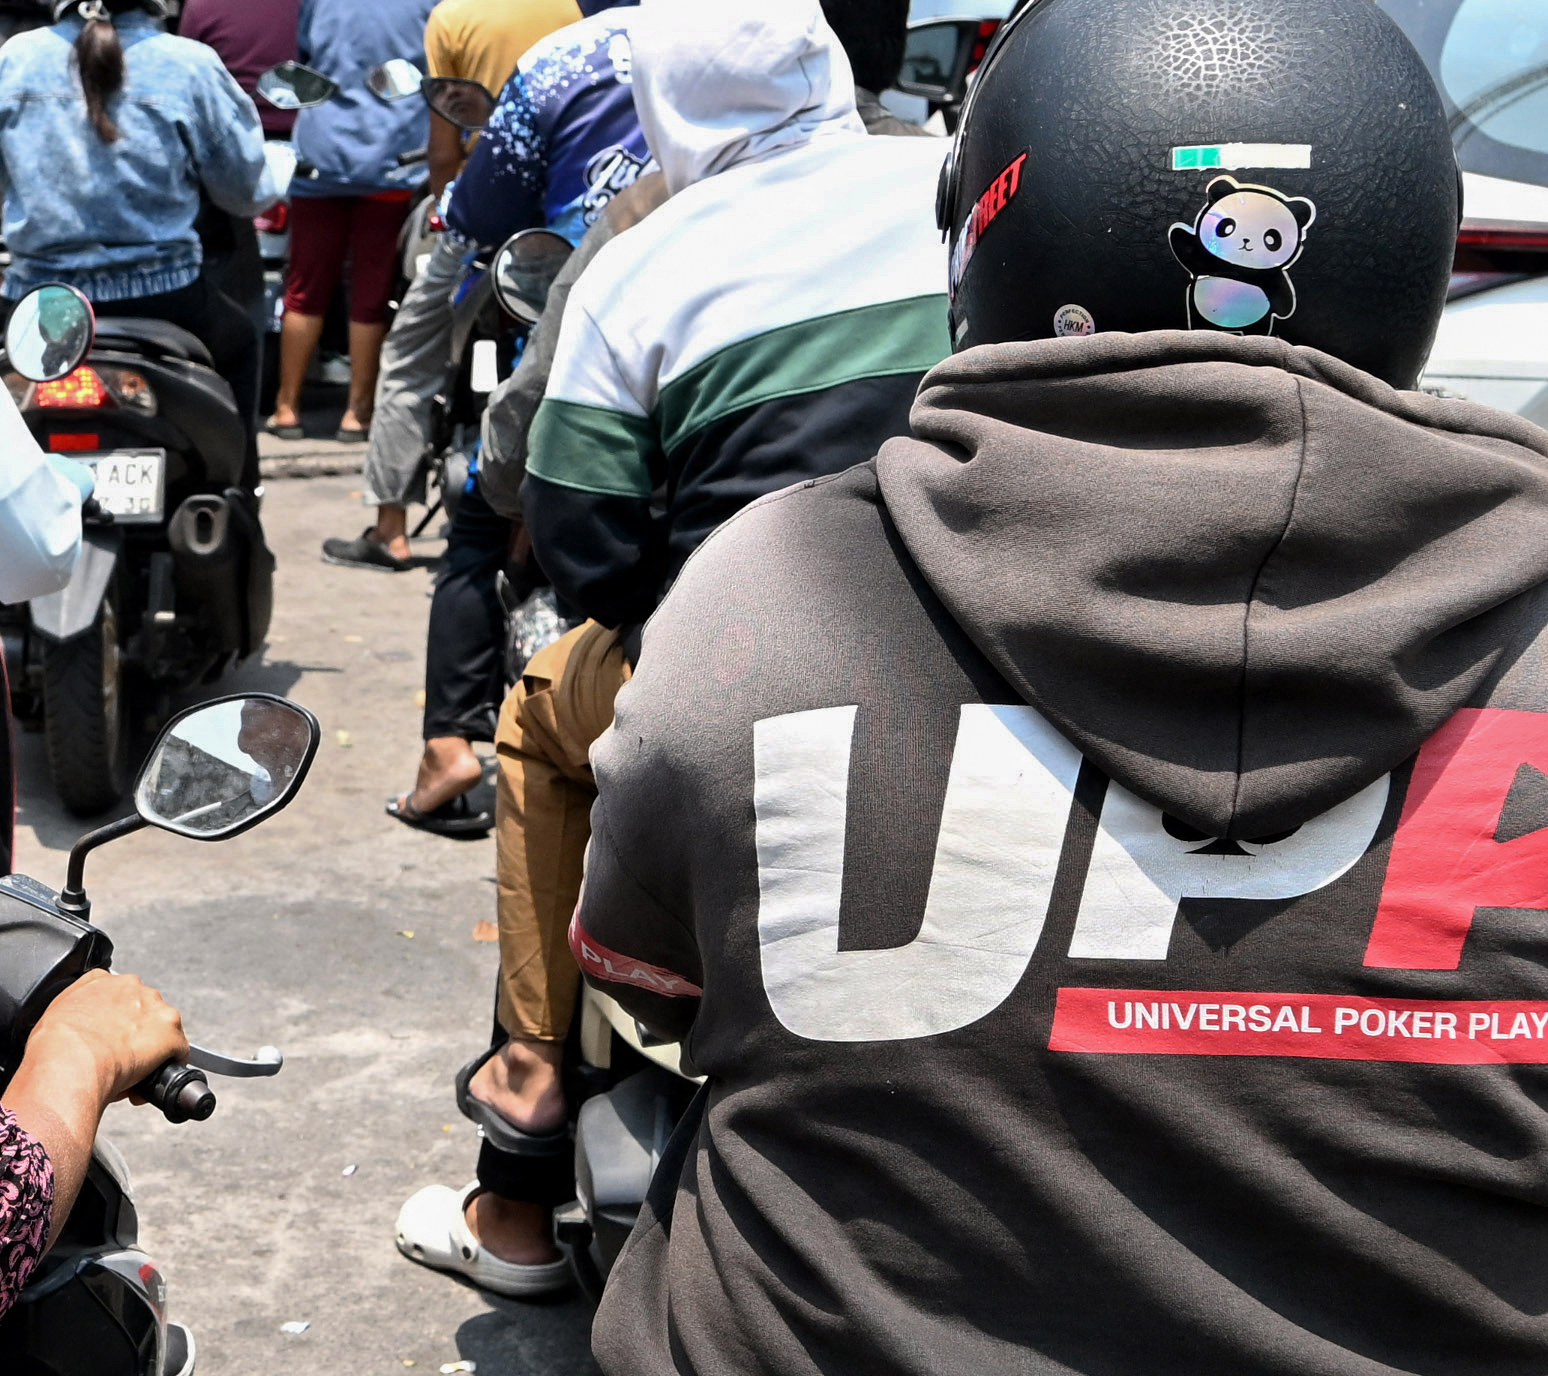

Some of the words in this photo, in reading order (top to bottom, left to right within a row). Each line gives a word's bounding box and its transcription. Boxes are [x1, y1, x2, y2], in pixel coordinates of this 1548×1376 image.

[1063, 319, 1084, 333] HKM
[108, 464, 153, 485] ACK
[580, 939, 680, 991] PLAY
[1106, 1000, 1322, 1035] UNIVERSAL
[1332, 1007, 1458, 1041] POKER
